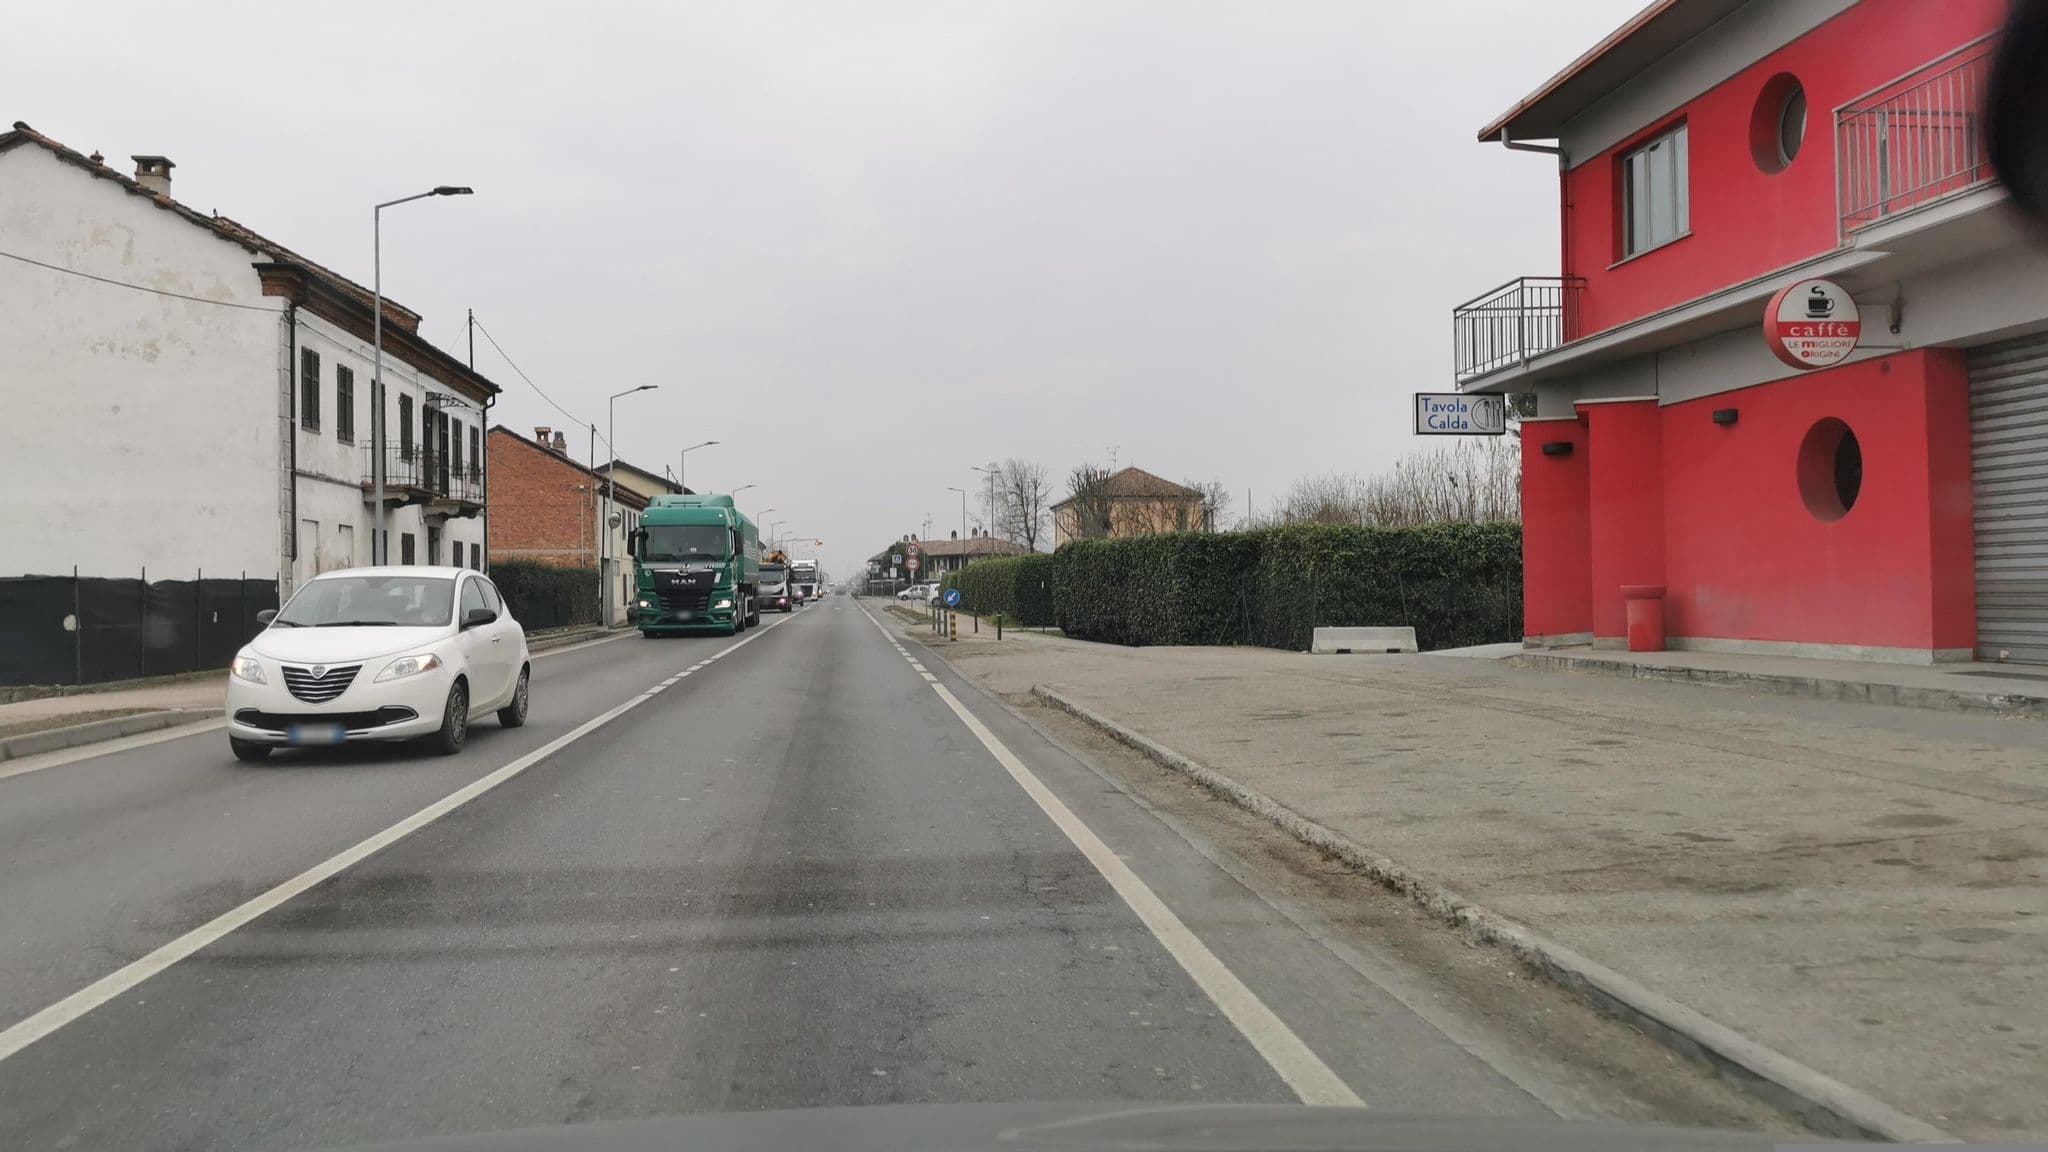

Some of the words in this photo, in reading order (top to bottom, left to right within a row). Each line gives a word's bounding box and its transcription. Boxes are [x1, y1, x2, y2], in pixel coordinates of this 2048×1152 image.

[1790, 323, 1849, 336] caffè
[1421, 397, 1468, 412] Tavola
[1428, 414, 1468, 429] Calda
